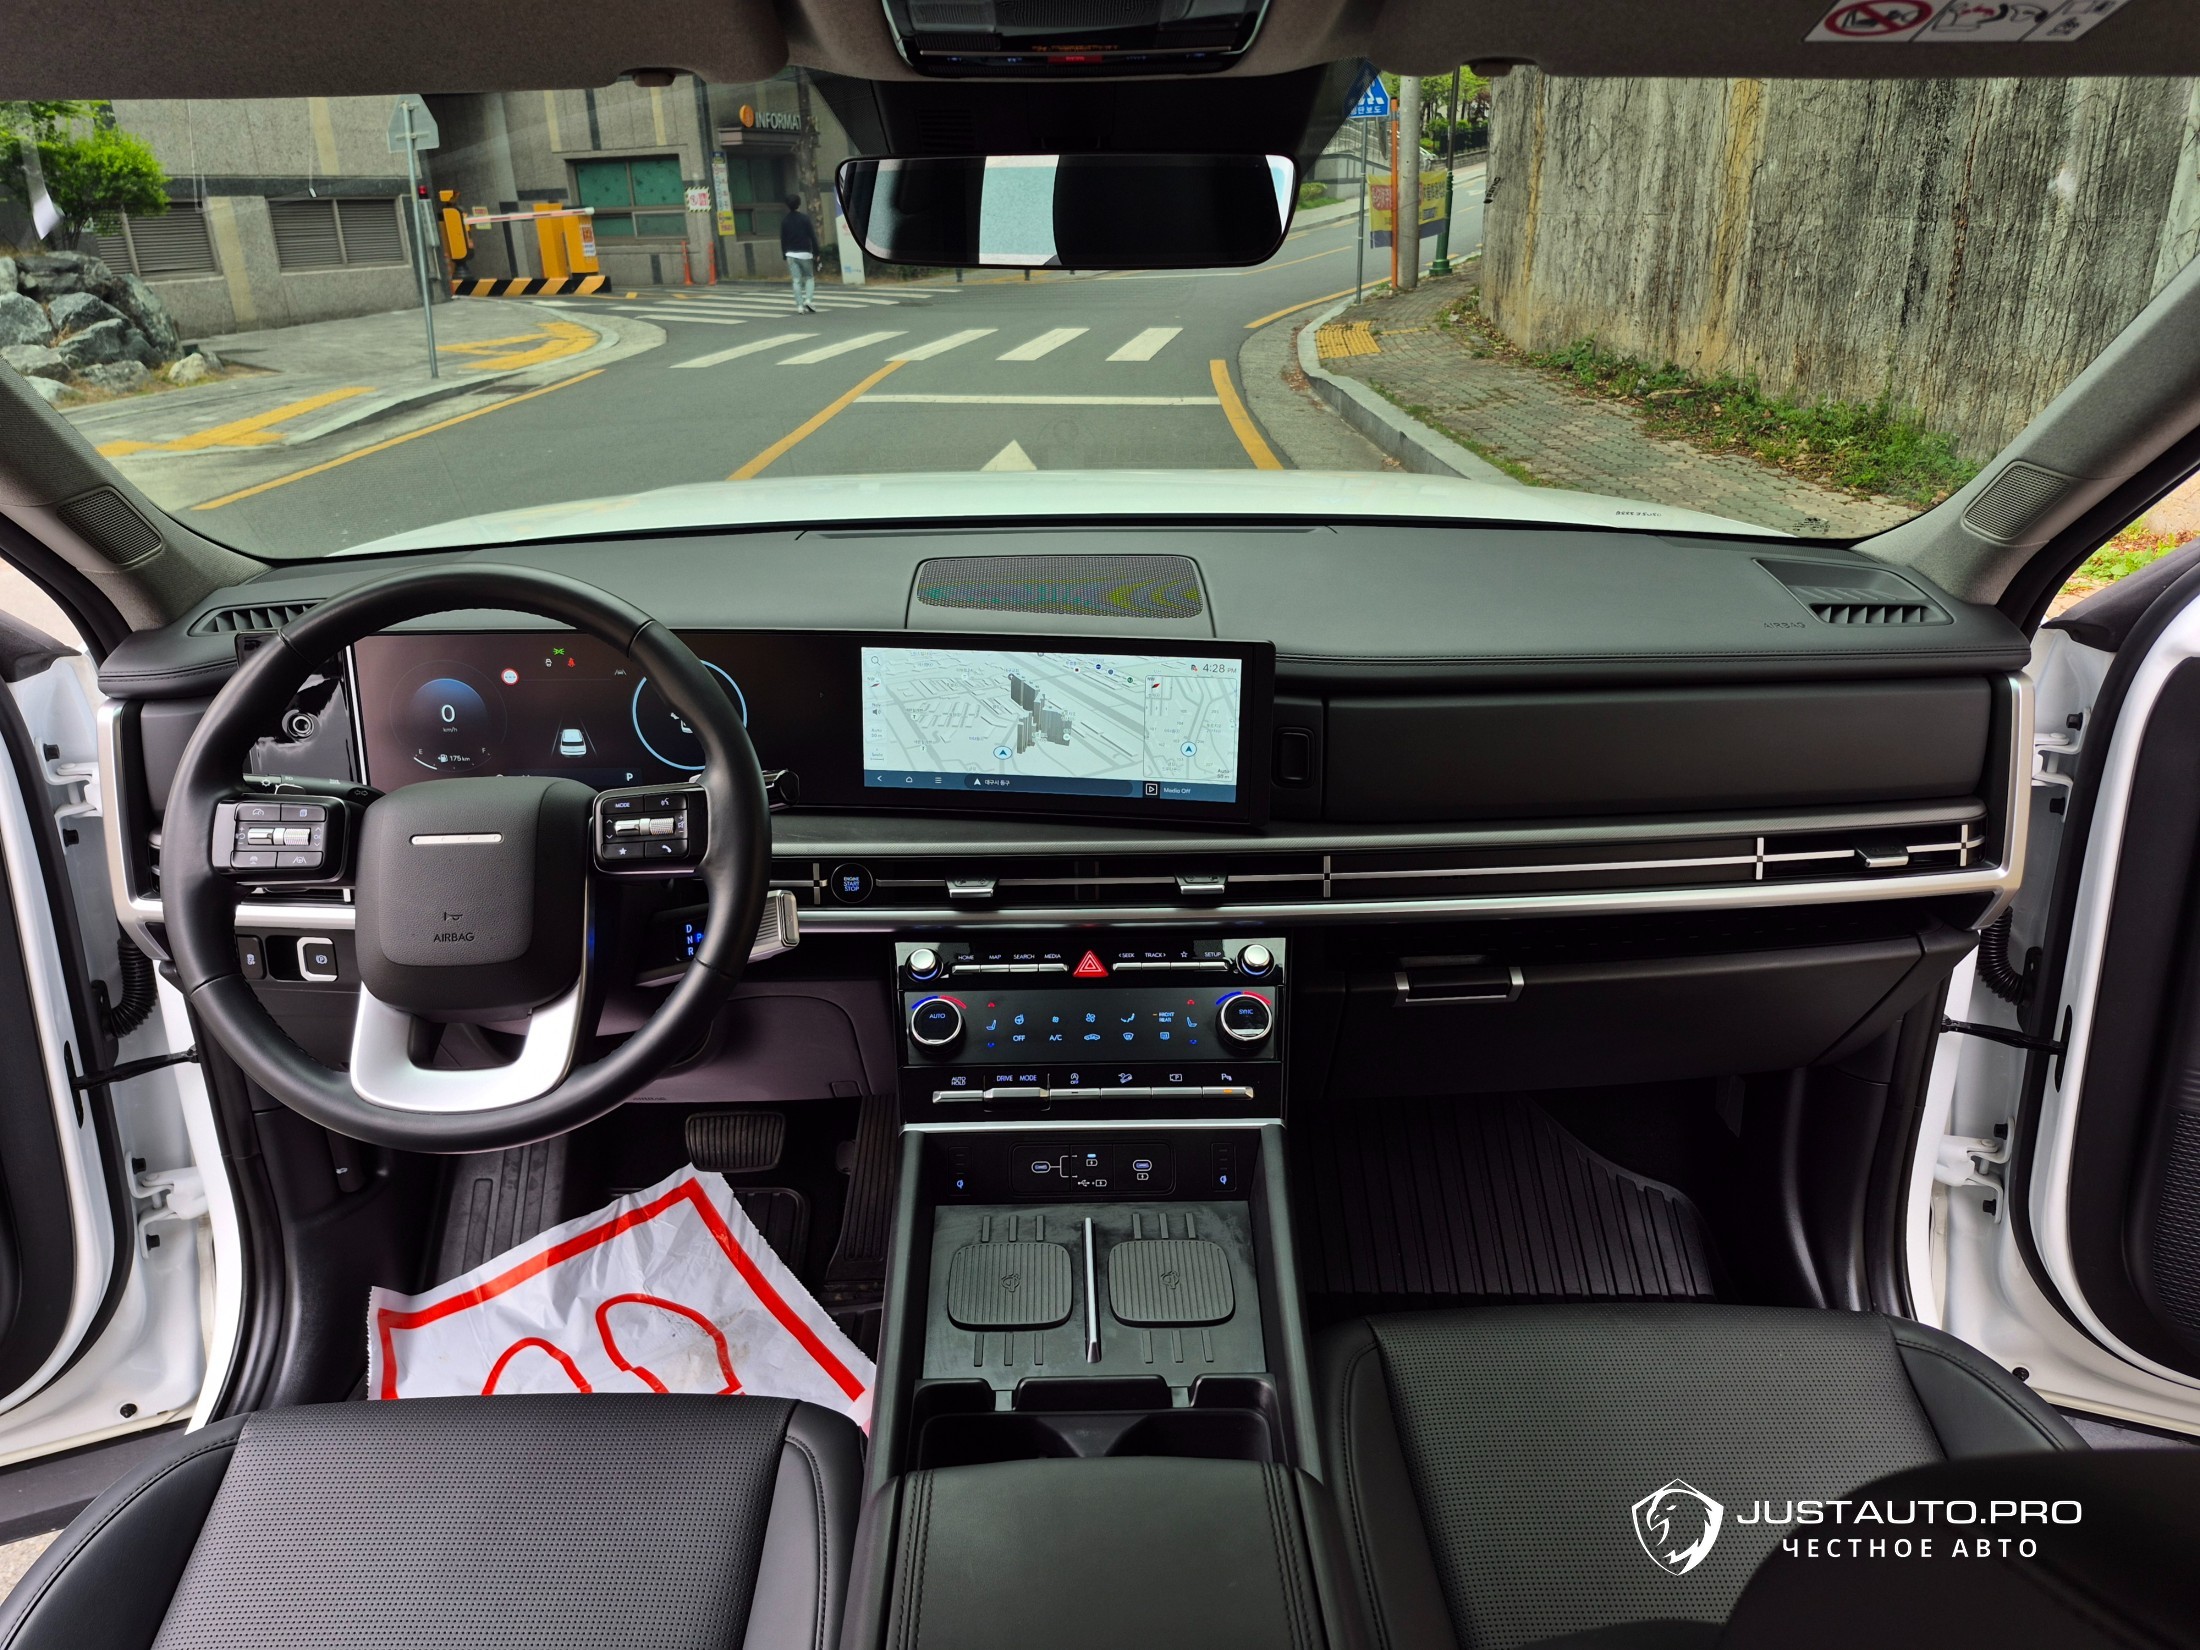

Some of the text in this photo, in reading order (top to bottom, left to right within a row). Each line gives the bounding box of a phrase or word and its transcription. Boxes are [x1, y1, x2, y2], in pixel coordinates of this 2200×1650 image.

[1203, 664, 1225, 673] 4:28
[441, 704, 455, 723] 0
[626, 773, 633, 782] P
[686, 924, 693, 933] D
[433, 932, 475, 943] AIRBAG
[687, 935, 693, 944] N
[688, 947, 694, 956] R
